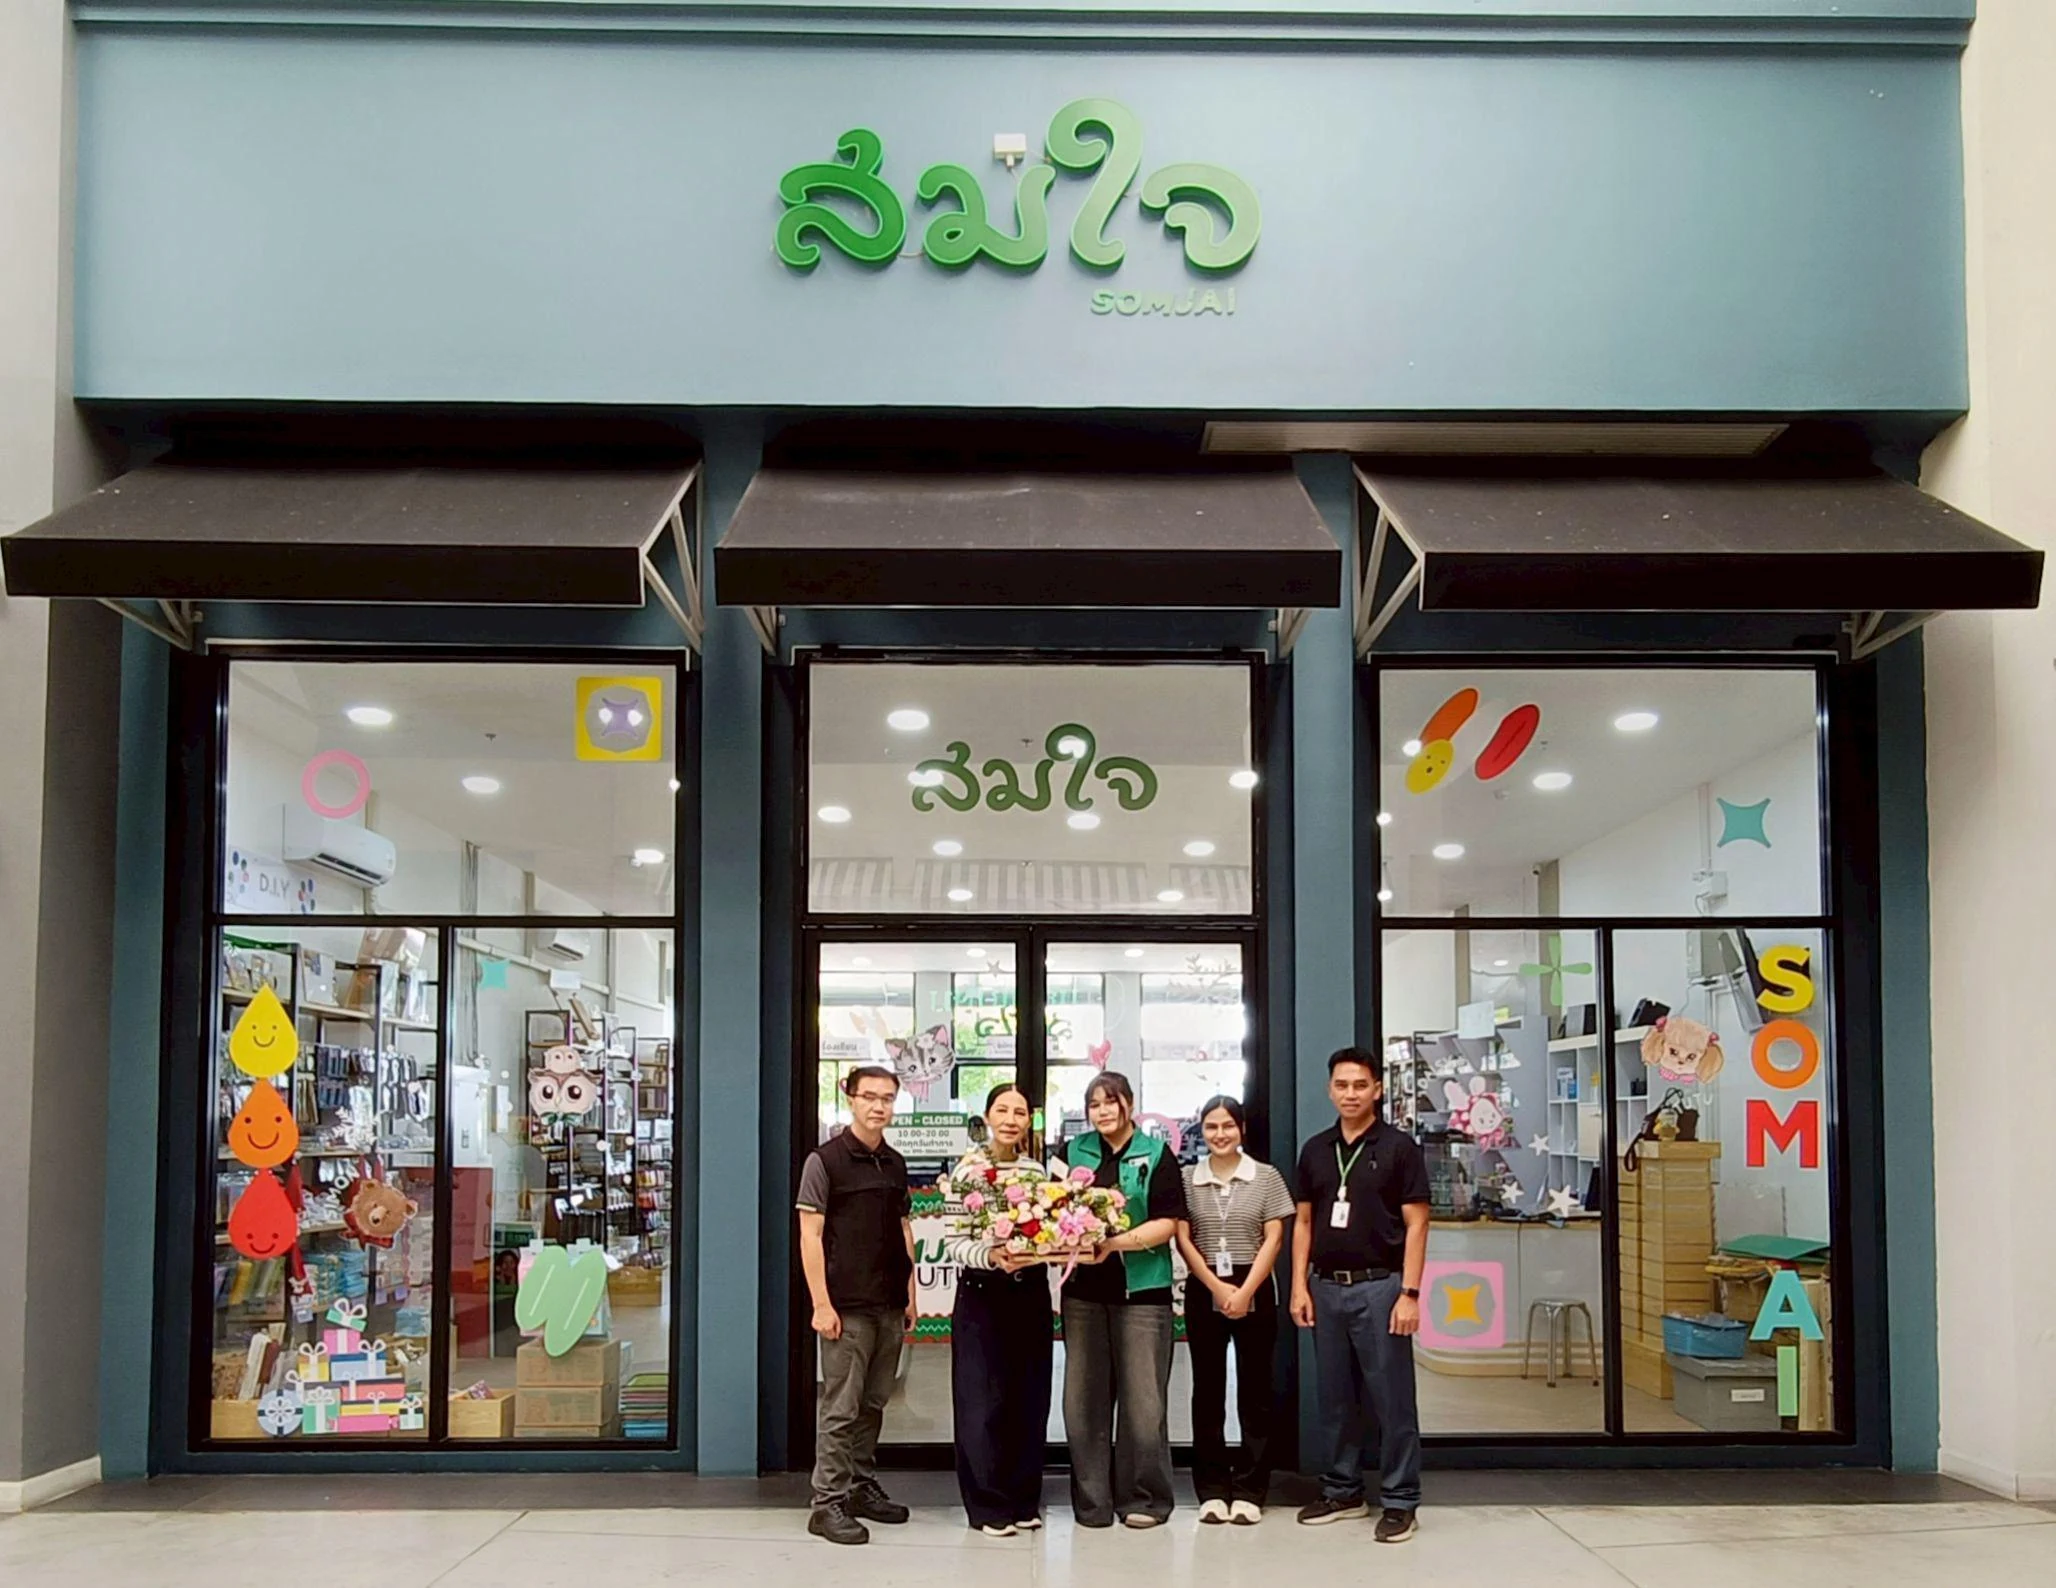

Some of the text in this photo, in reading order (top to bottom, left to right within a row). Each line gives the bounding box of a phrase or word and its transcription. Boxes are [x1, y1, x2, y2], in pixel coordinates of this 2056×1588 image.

[773, 97, 1262, 268] สมใจ
[1090, 286, 1236, 317] SOMJAI
[912, 723, 1158, 811] สมใจ
[922, 1114, 963, 1126] CLOSED
